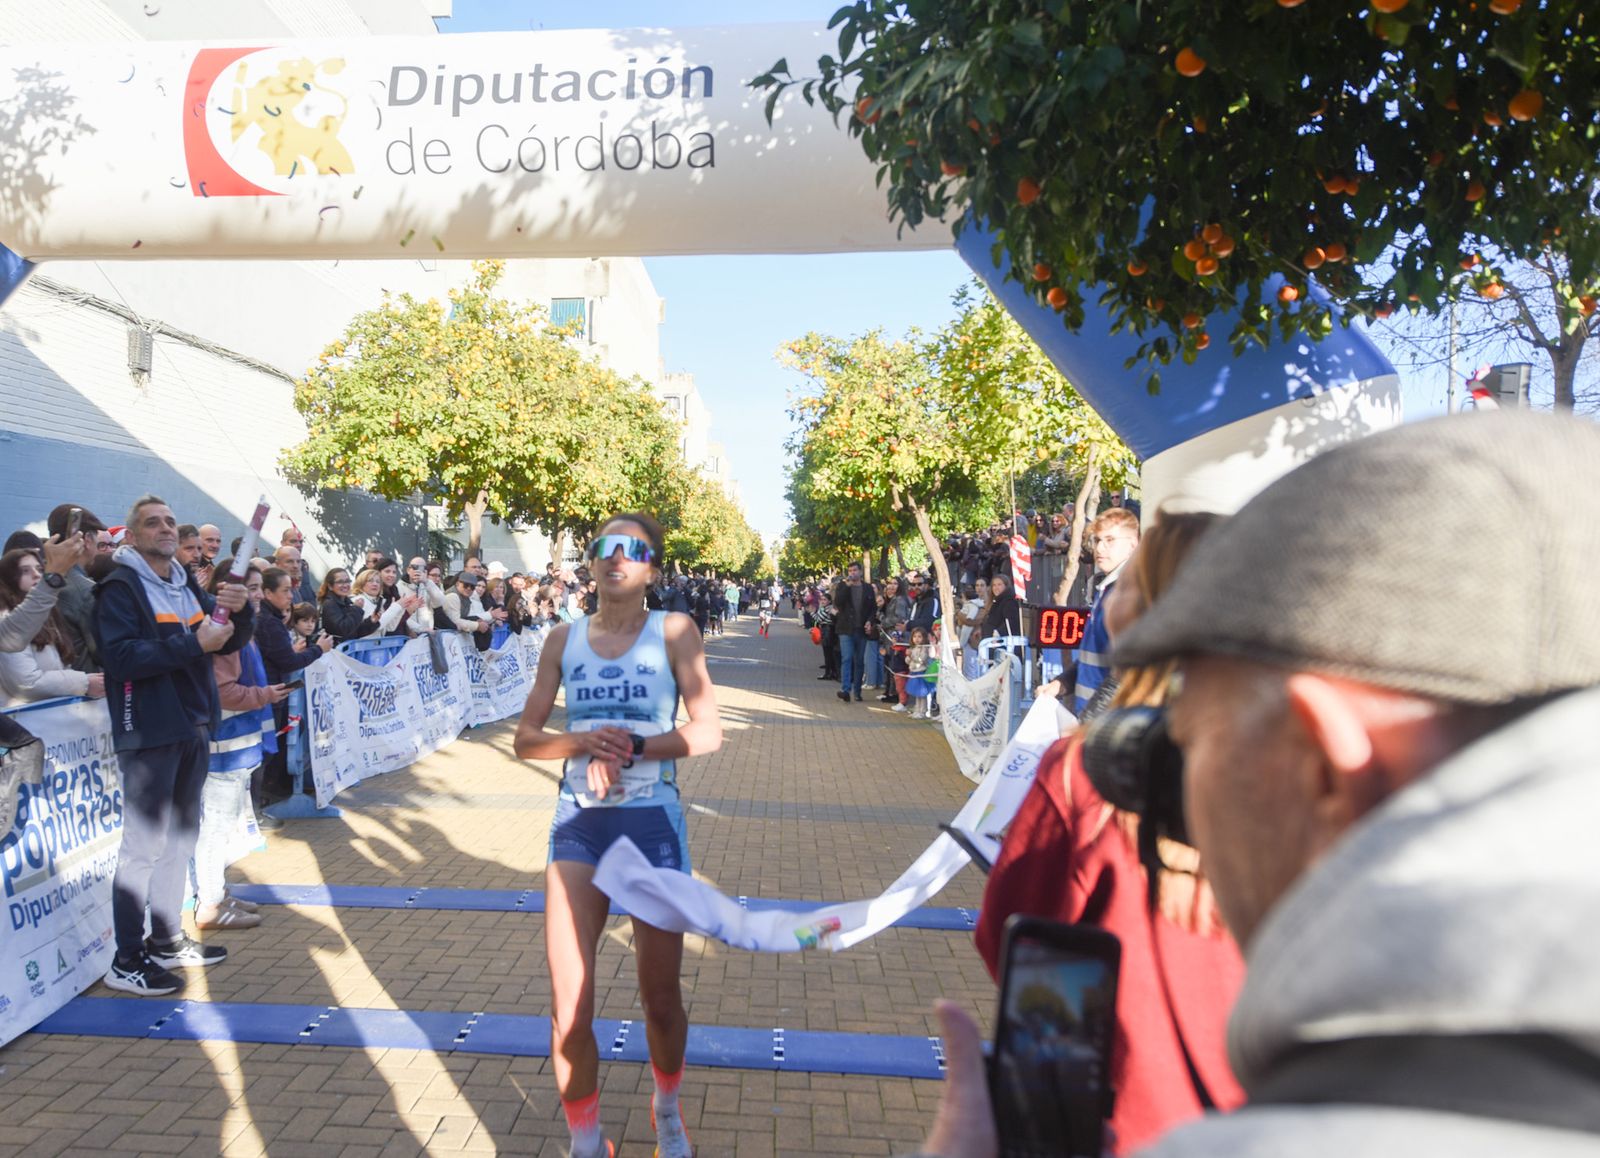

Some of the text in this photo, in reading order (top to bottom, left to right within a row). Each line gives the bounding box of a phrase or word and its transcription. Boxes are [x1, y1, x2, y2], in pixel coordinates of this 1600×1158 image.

[386, 58, 714, 118] Diputación
[385, 120, 716, 176] de Córdoba
[1039, 609, 1091, 645] 00:
[576, 680, 649, 703] nerja
[14, 760, 104, 831] arreras
